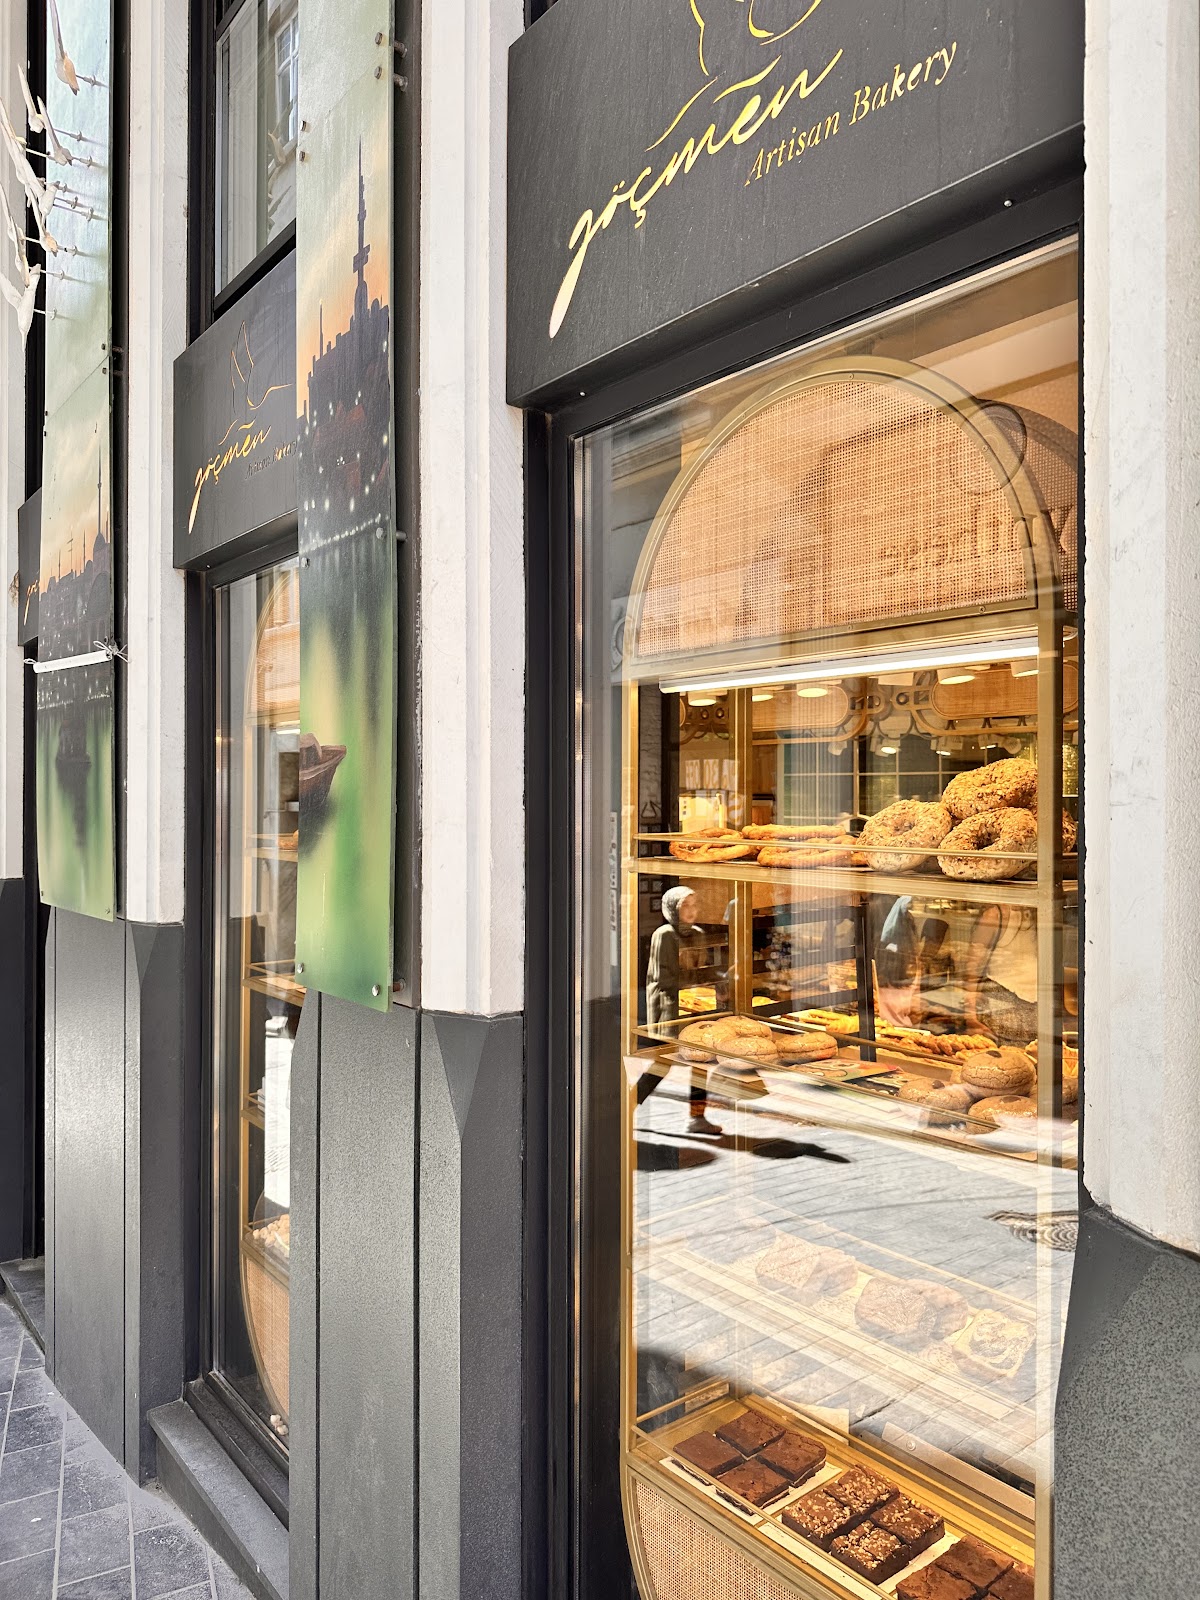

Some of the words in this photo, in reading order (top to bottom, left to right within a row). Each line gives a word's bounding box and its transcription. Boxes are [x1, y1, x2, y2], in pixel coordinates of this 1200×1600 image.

[548, 48, 844, 339] göçmen
[744, 111, 840, 187] Artisan
[848, 41, 957, 127] Bakery
